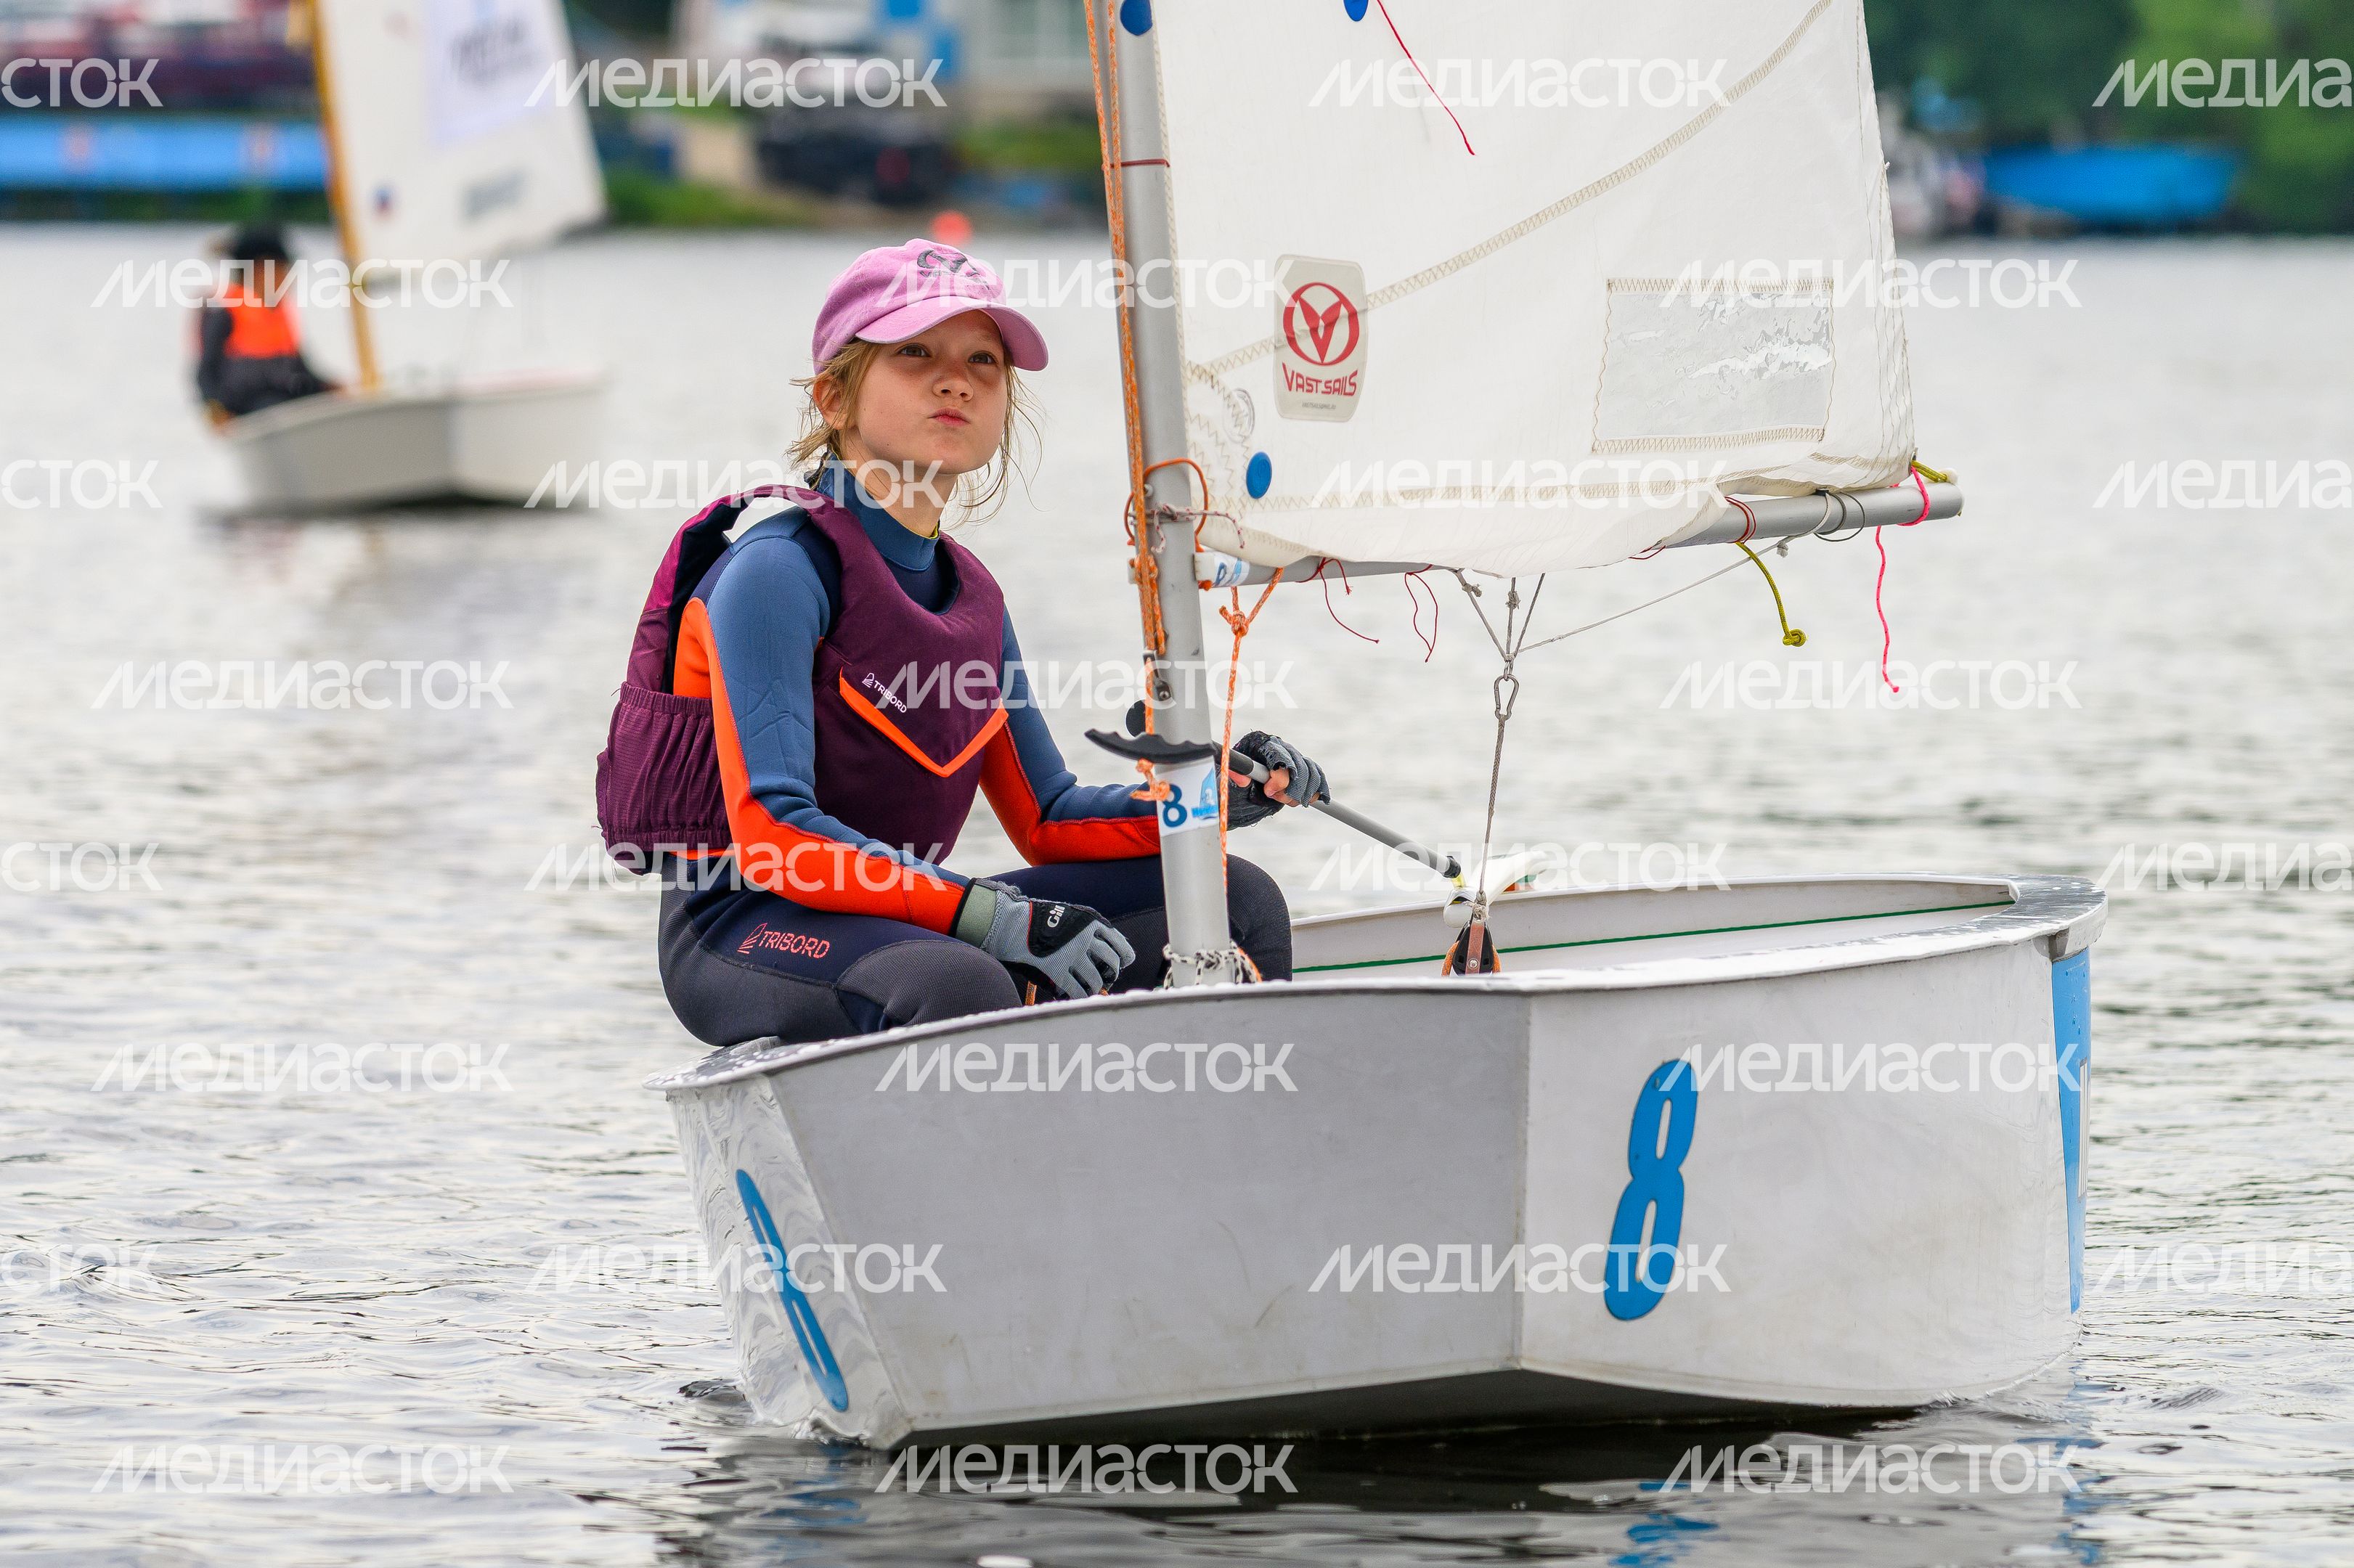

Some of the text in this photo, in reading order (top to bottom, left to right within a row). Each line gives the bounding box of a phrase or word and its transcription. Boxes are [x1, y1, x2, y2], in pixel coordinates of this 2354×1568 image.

[873, 679, 907, 714] TRIBORD
[1162, 783, 1188, 828] 8
[1047, 905, 1065, 928] Gill
[758, 930, 831, 960] TRIBORD
[1603, 1058, 1699, 1322] 8
[736, 1168, 849, 1413] 8
